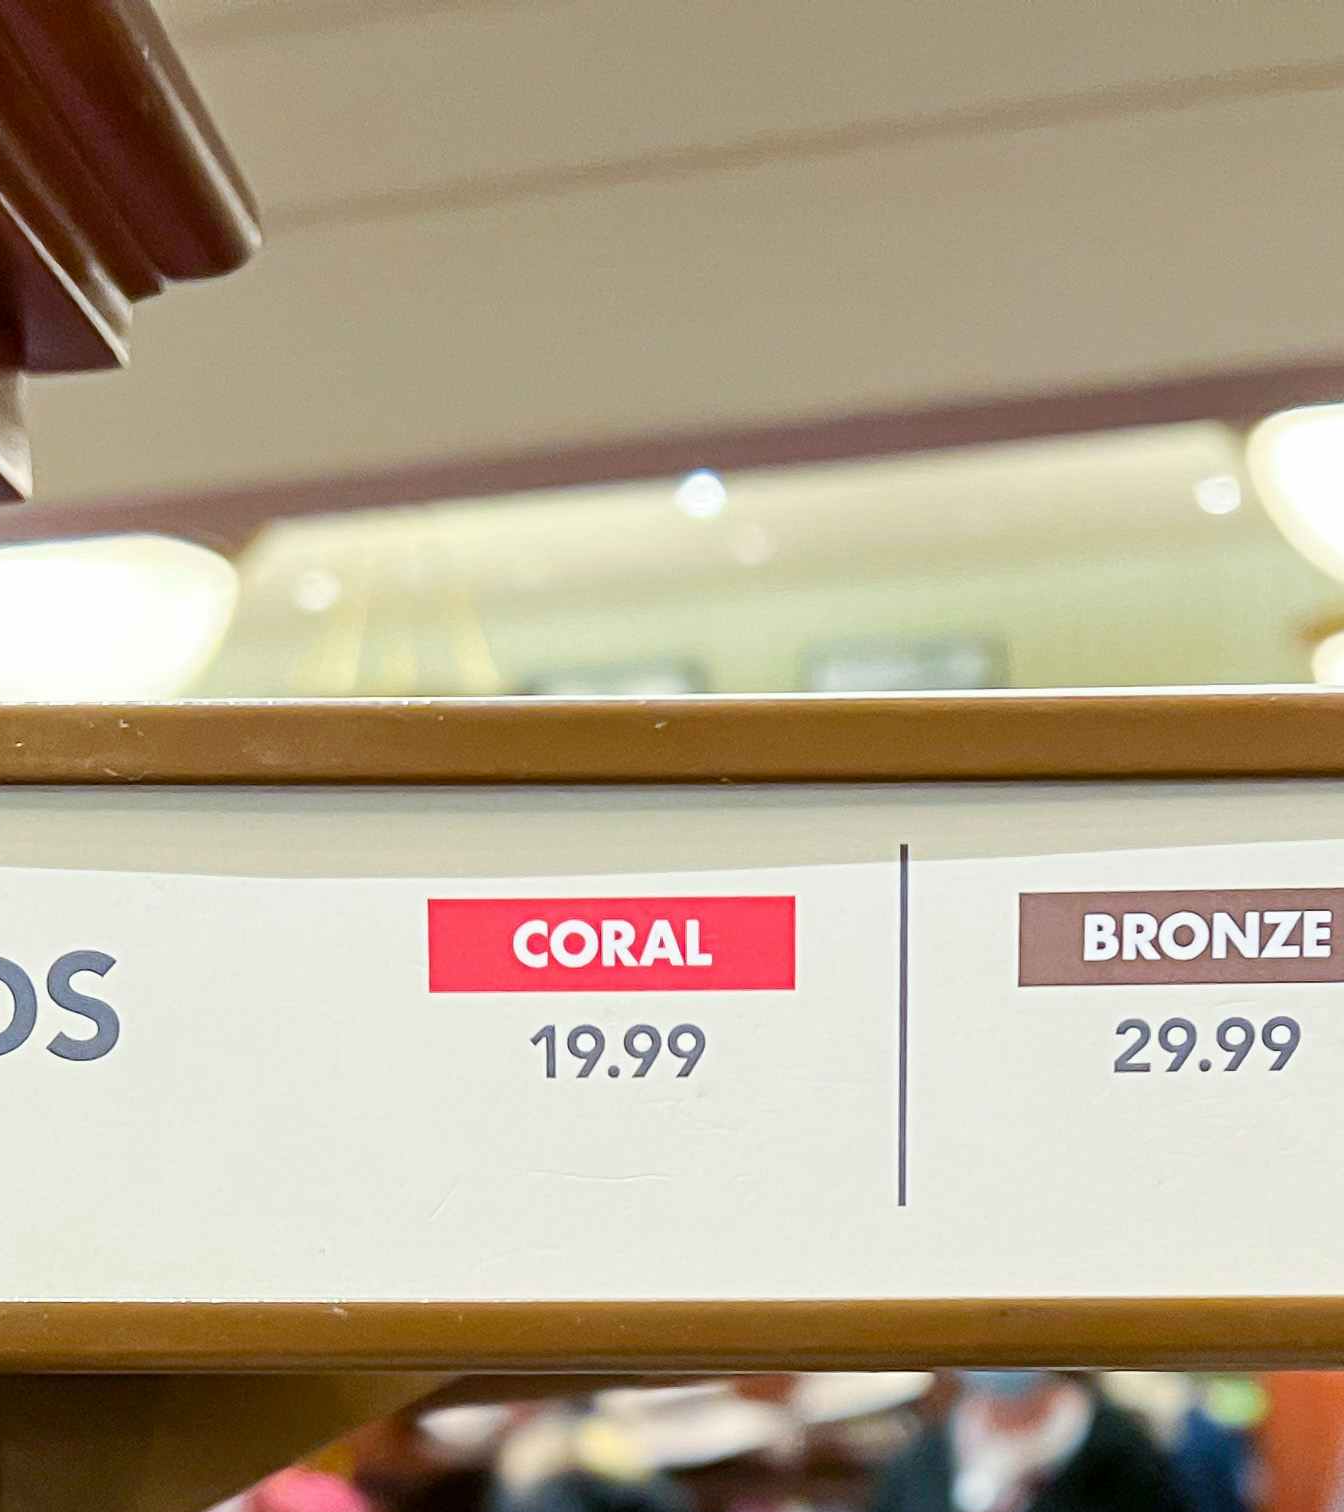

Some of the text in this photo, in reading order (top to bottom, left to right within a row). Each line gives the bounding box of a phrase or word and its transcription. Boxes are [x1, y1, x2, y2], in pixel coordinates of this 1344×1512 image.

[512, 918, 713, 968] CORAL
[1083, 909, 1332, 961] BRONZE
[530, 1024, 707, 1079] 19.99
[1113, 1016, 1301, 1073] 29.99
